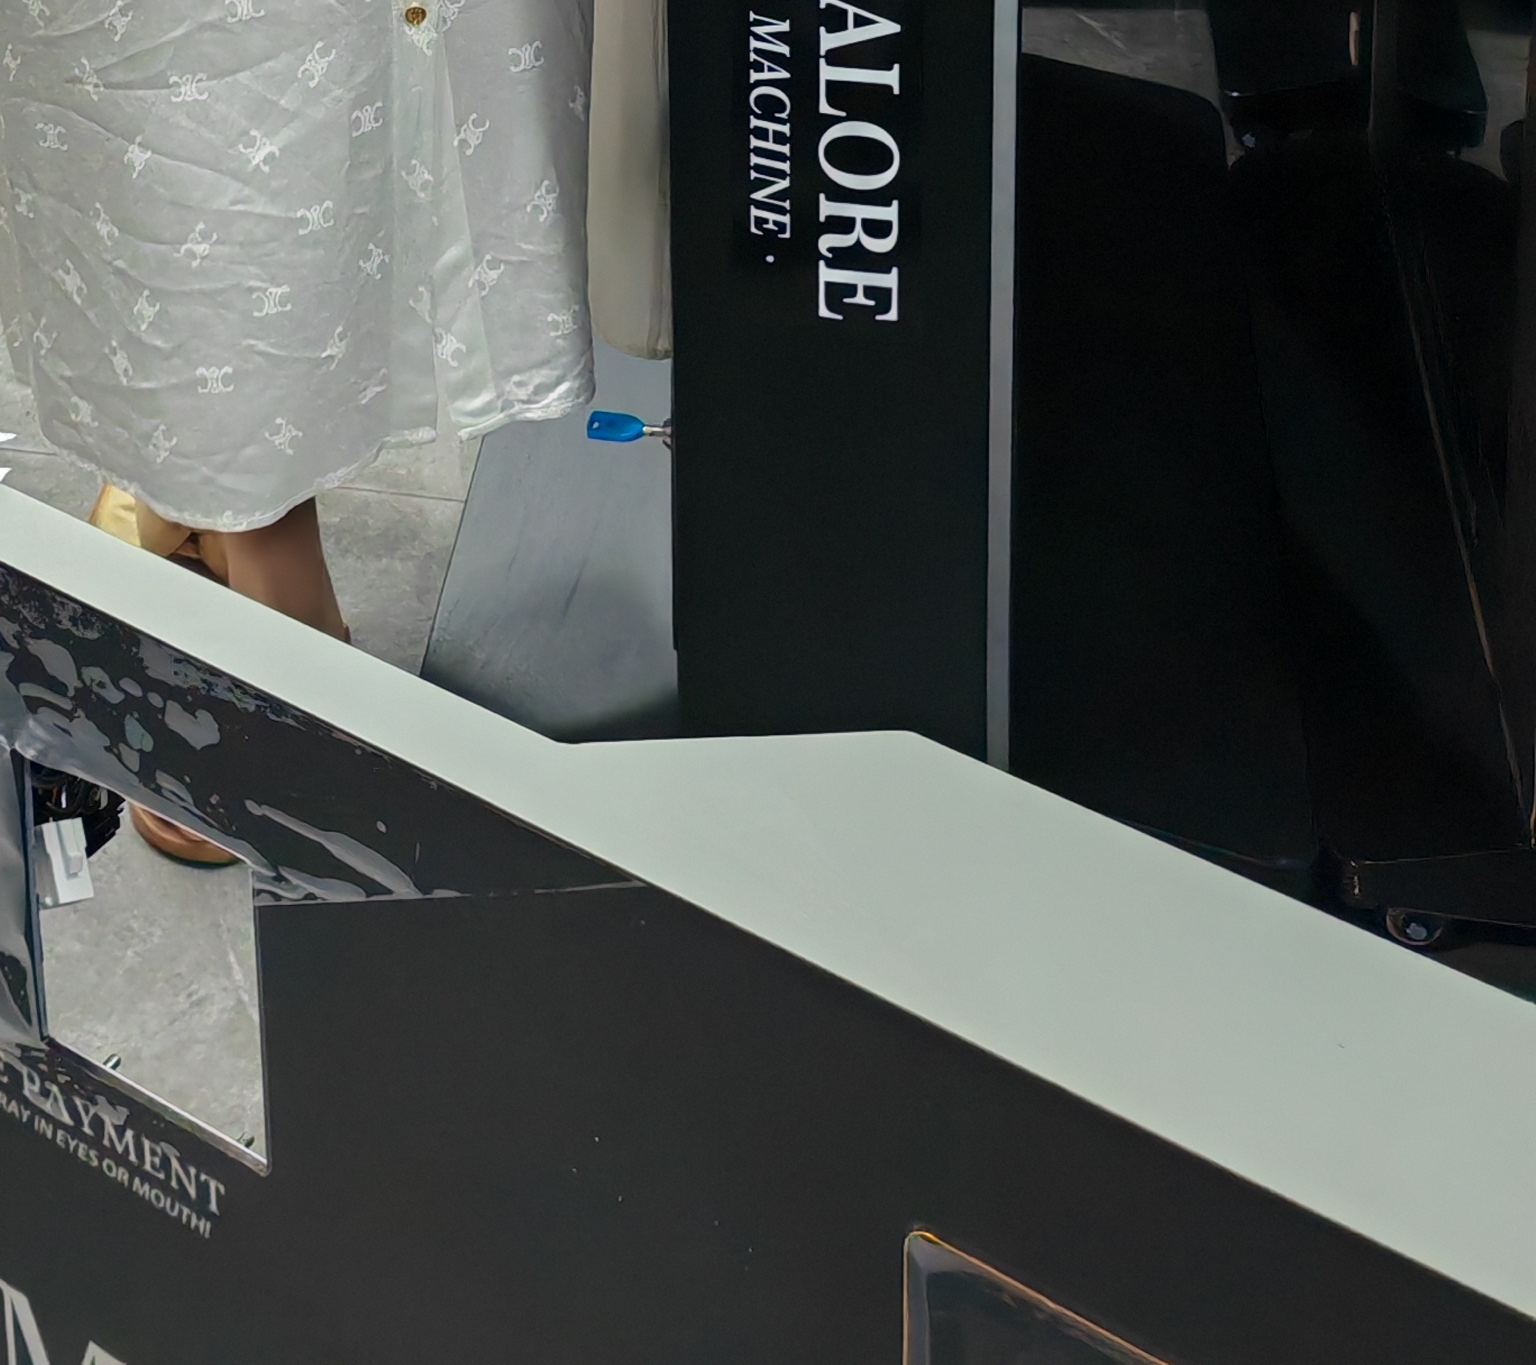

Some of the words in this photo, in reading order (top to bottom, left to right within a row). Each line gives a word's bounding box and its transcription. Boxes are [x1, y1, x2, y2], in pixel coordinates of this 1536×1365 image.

[749, 10, 791, 238] MACHINE
[21, 1065, 226, 1217] PAYMENT
[33, 1114, 54, 1141] IN
[56, 1129, 100, 1168] EYES
[101, 1157, 129, 1190] OR
